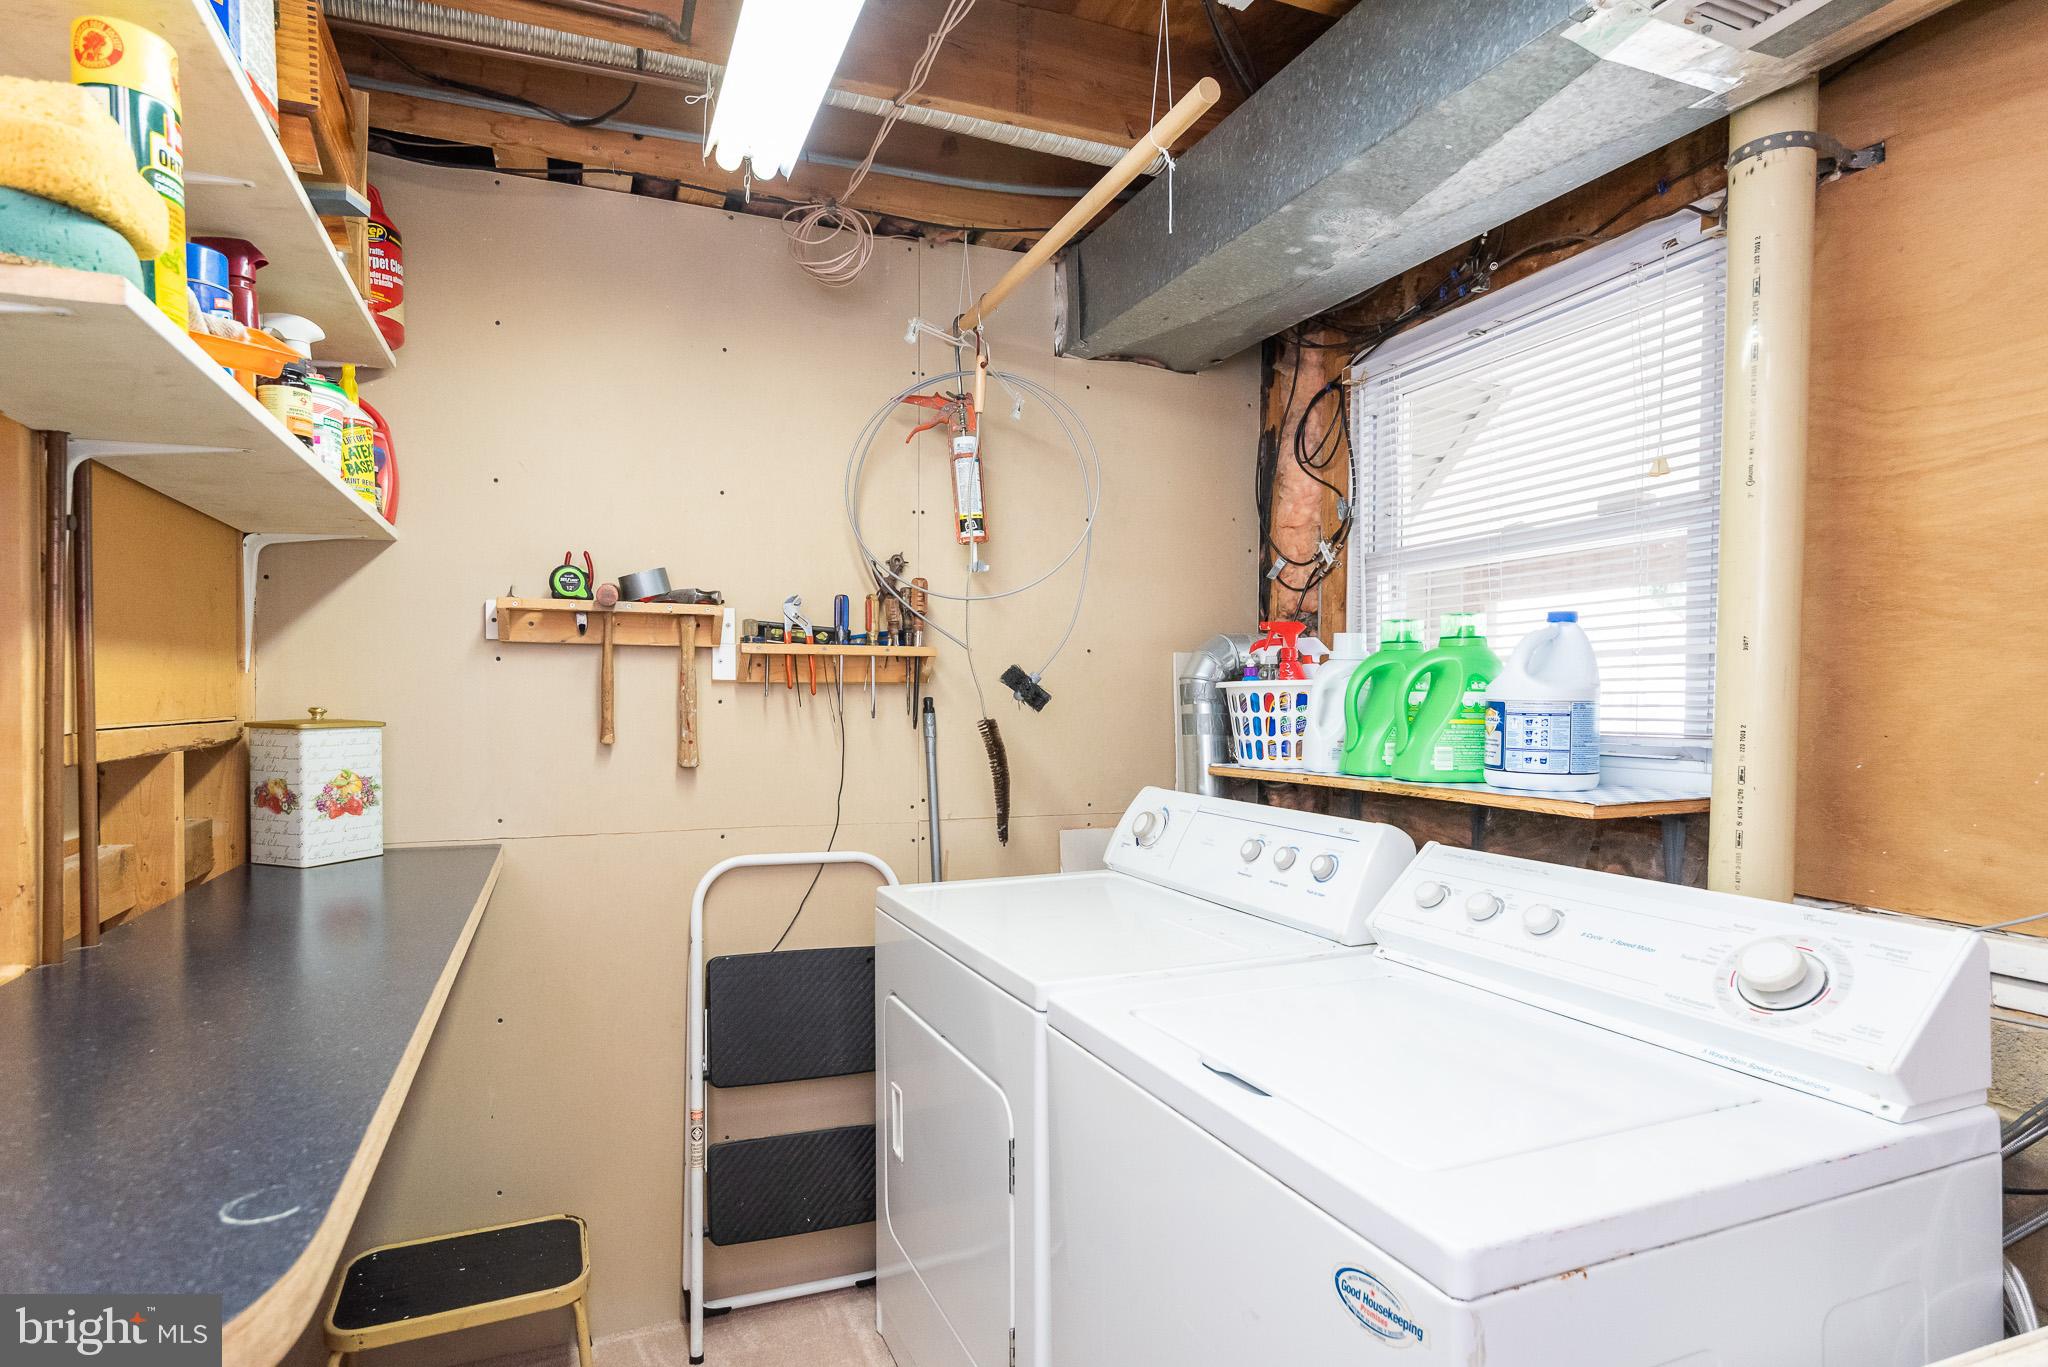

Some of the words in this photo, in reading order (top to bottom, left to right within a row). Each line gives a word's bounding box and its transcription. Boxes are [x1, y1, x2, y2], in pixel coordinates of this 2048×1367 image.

[368, 256, 390, 271] rpet
[1341, 1279, 1361, 1300] Good
[1362, 1292, 1424, 1341] Housekeeping
